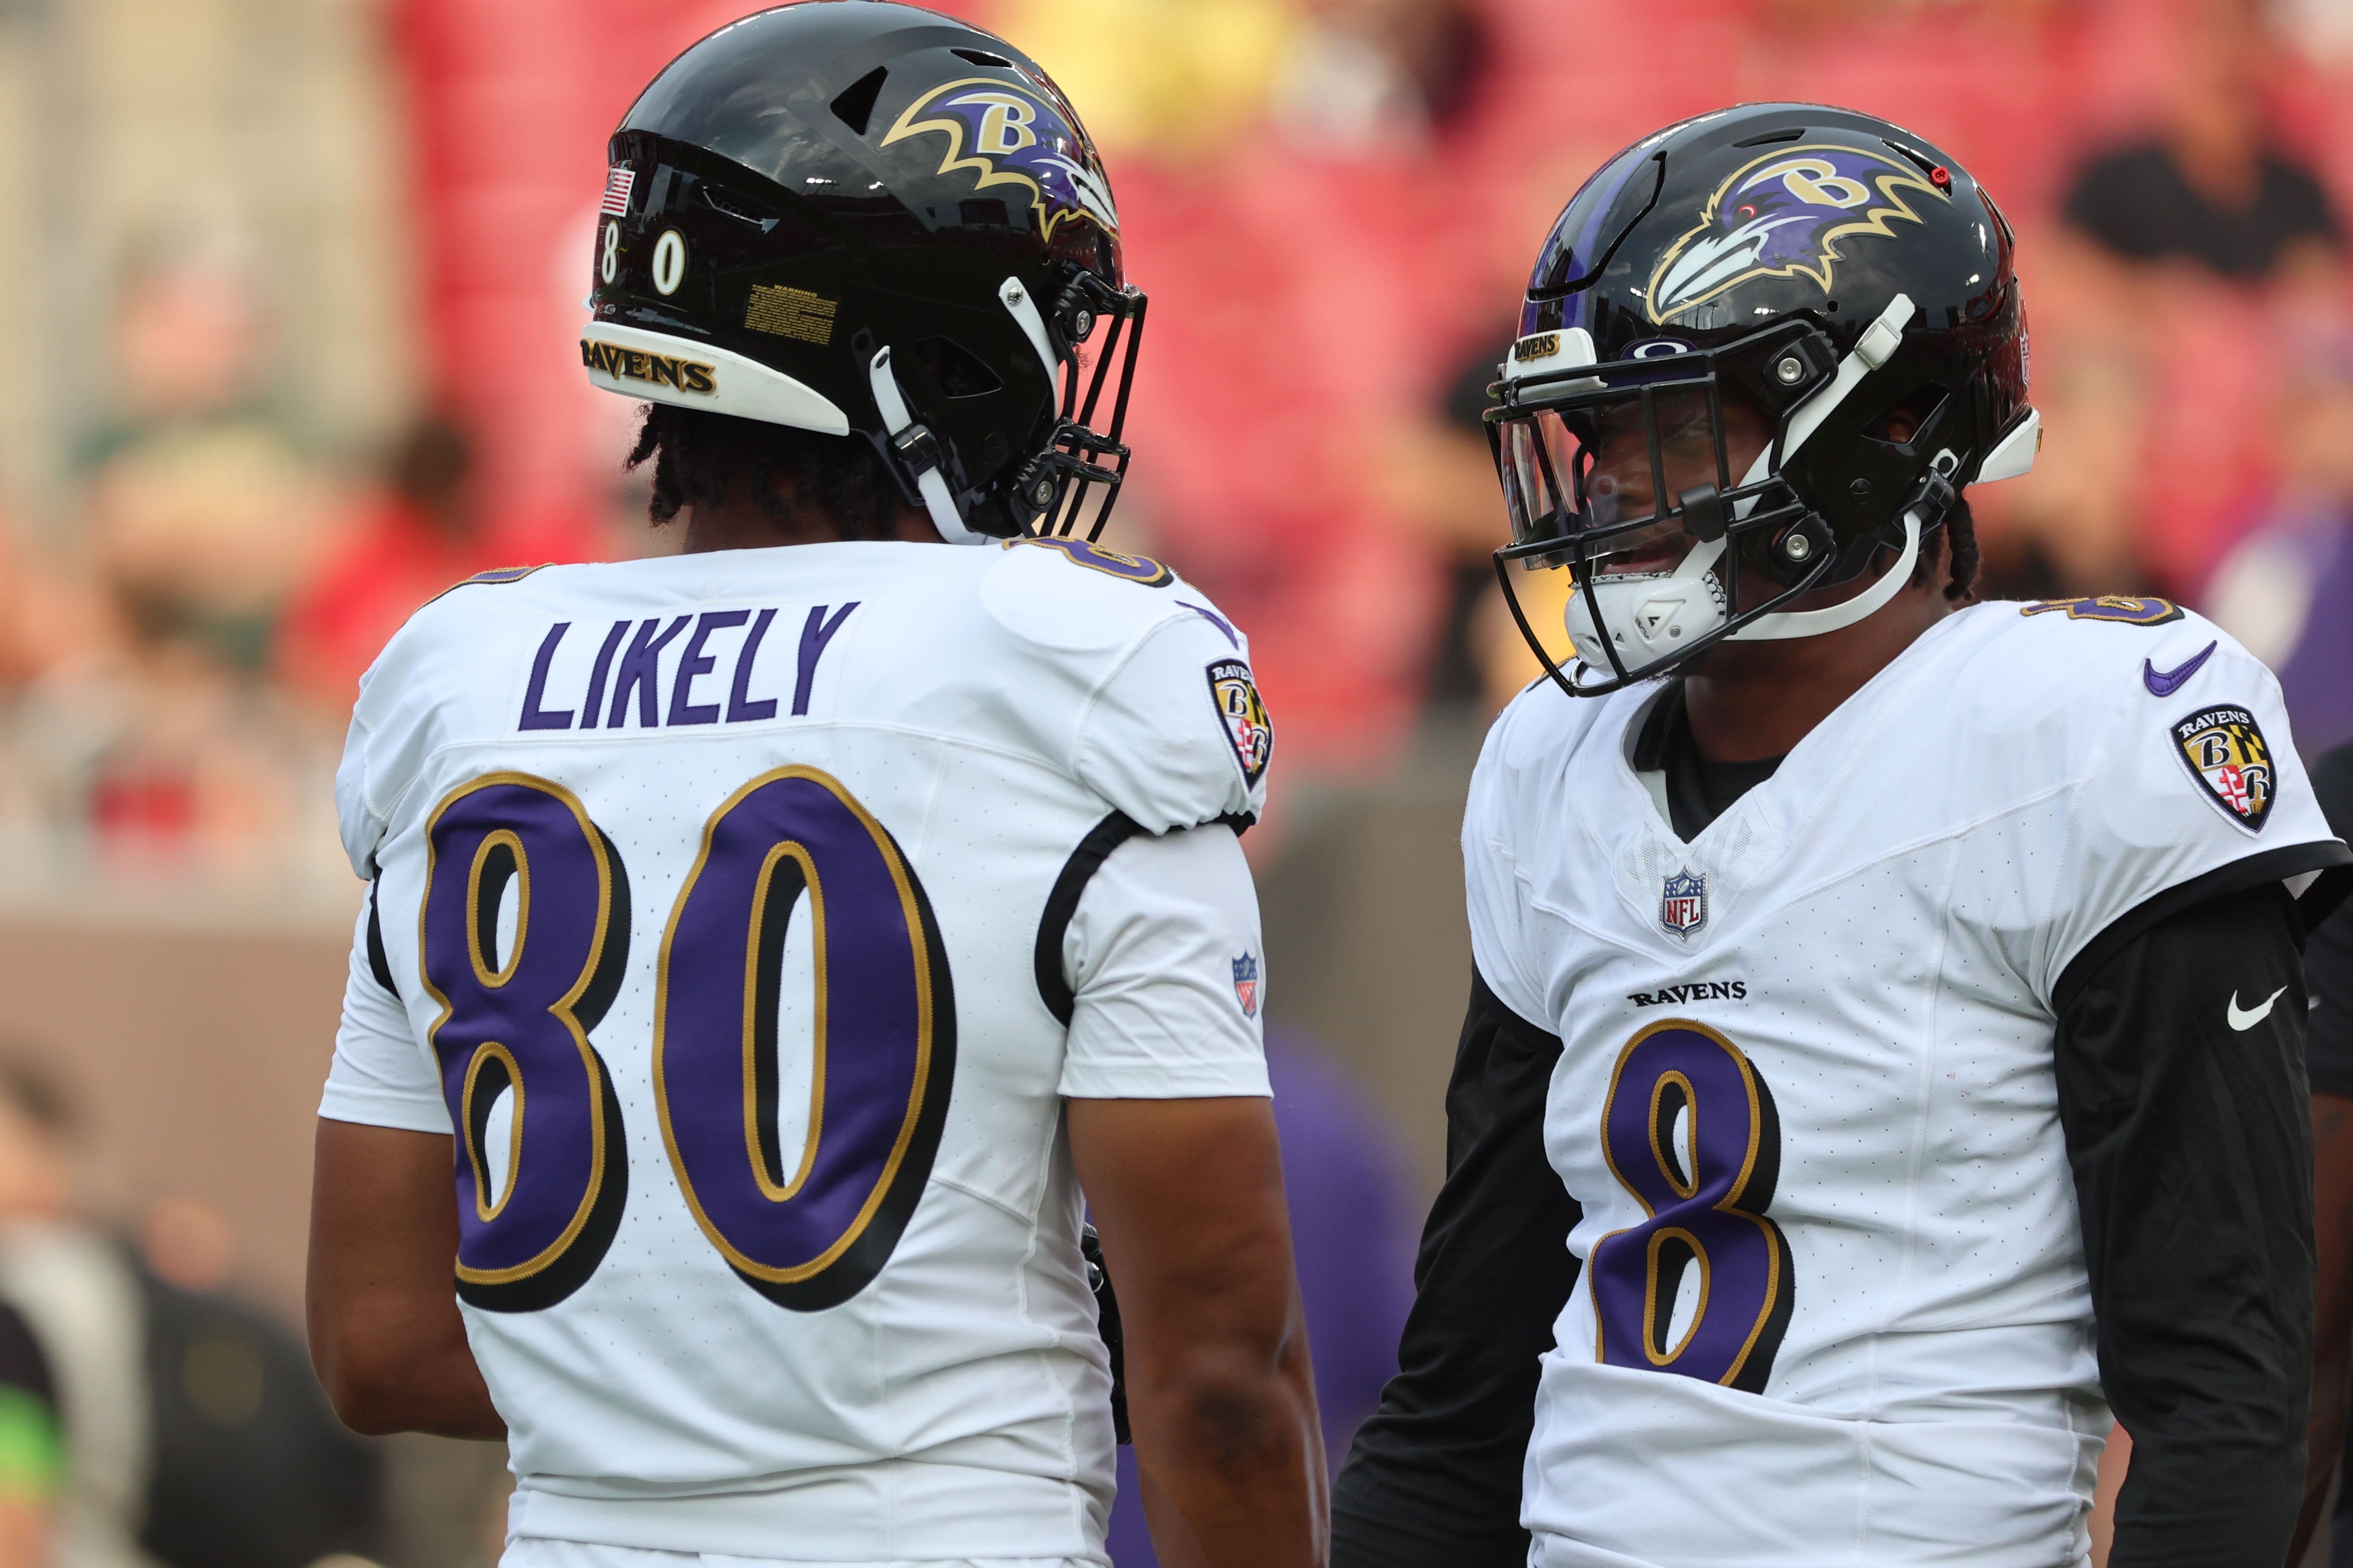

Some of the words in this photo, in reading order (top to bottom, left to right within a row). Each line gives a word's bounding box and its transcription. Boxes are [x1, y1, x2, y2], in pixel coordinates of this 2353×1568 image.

[774, 284, 818, 298] WARNING
[1514, 334, 1561, 362] RAVENS
[518, 601, 861, 731] LIKELY
[2178, 711, 2250, 738] RAVENS
[2187, 730, 2231, 770] B
[1666, 899, 1699, 927] NFL
[1627, 981, 1747, 1007] RAVENS
[418, 764, 957, 1313] 80
[1588, 1017, 1795, 1395] 8
